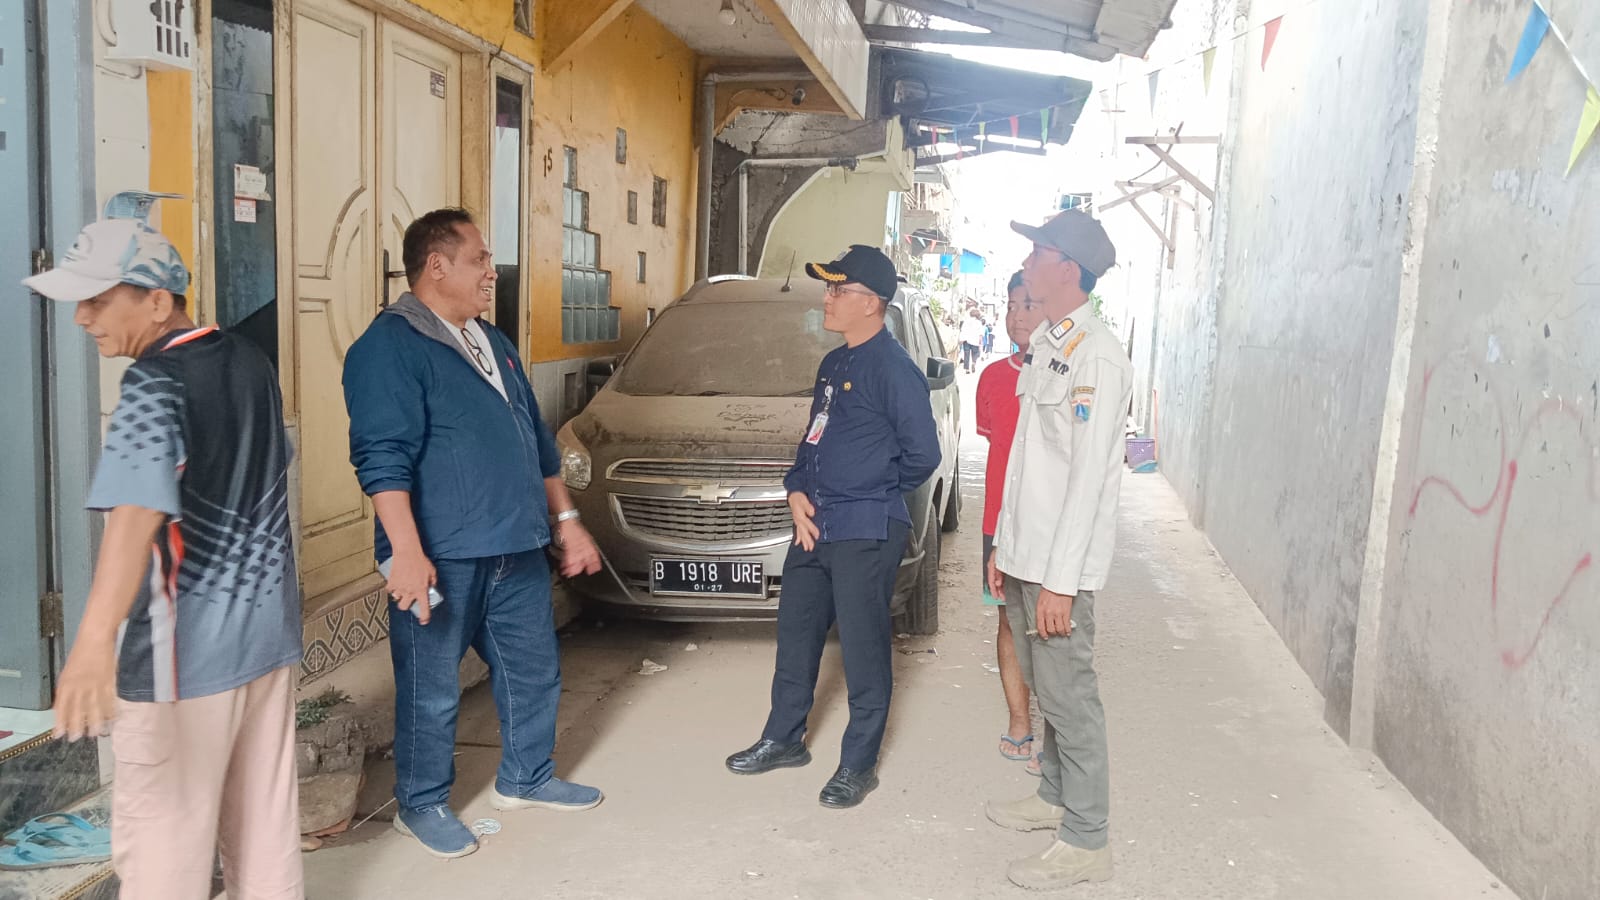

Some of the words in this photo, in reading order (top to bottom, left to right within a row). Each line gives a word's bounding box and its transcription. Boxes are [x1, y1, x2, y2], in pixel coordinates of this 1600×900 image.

[543, 147, 553, 178] 15
[655, 561, 665, 580] B
[679, 562, 718, 582] 1918
[731, 563, 761, 584] URE
